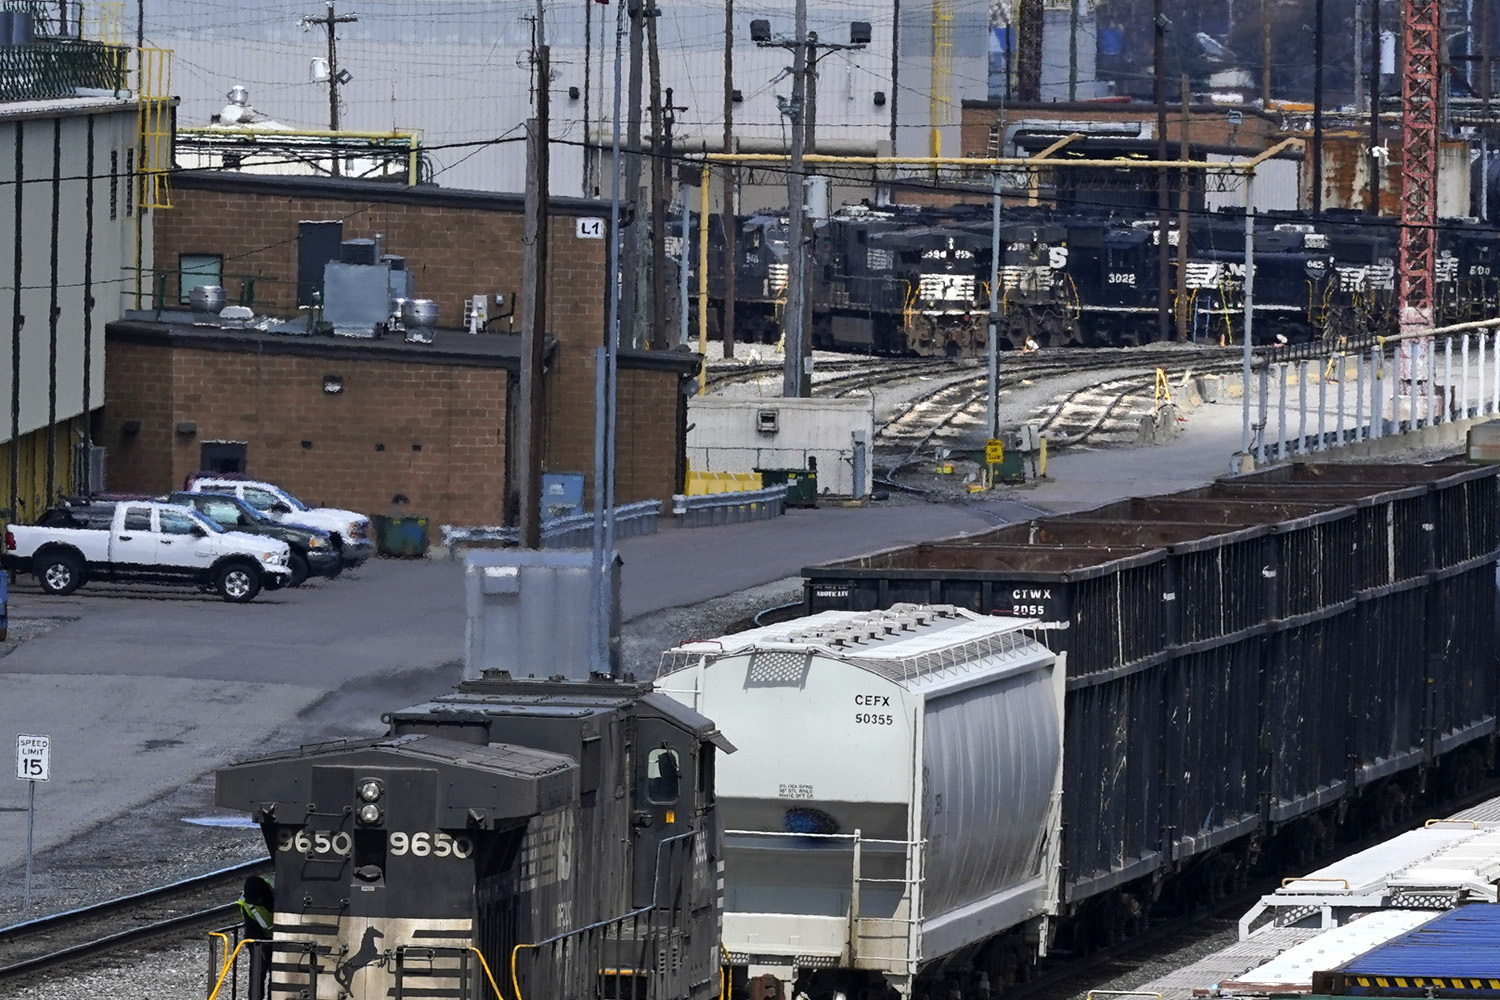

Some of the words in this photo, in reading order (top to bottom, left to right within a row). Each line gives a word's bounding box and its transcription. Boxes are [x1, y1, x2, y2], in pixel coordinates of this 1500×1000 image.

[581, 222, 599, 235] L1
[1108, 273, 1136, 285] 3022
[1013, 589, 1051, 599] CTWX
[1013, 605, 1044, 615] 2055
[855, 694, 890, 706] CEFX
[855, 713, 893, 725] 50355
[23, 758, 43, 776] 15
[278, 828, 352, 855] 9650
[390, 831, 474, 859] 9650
